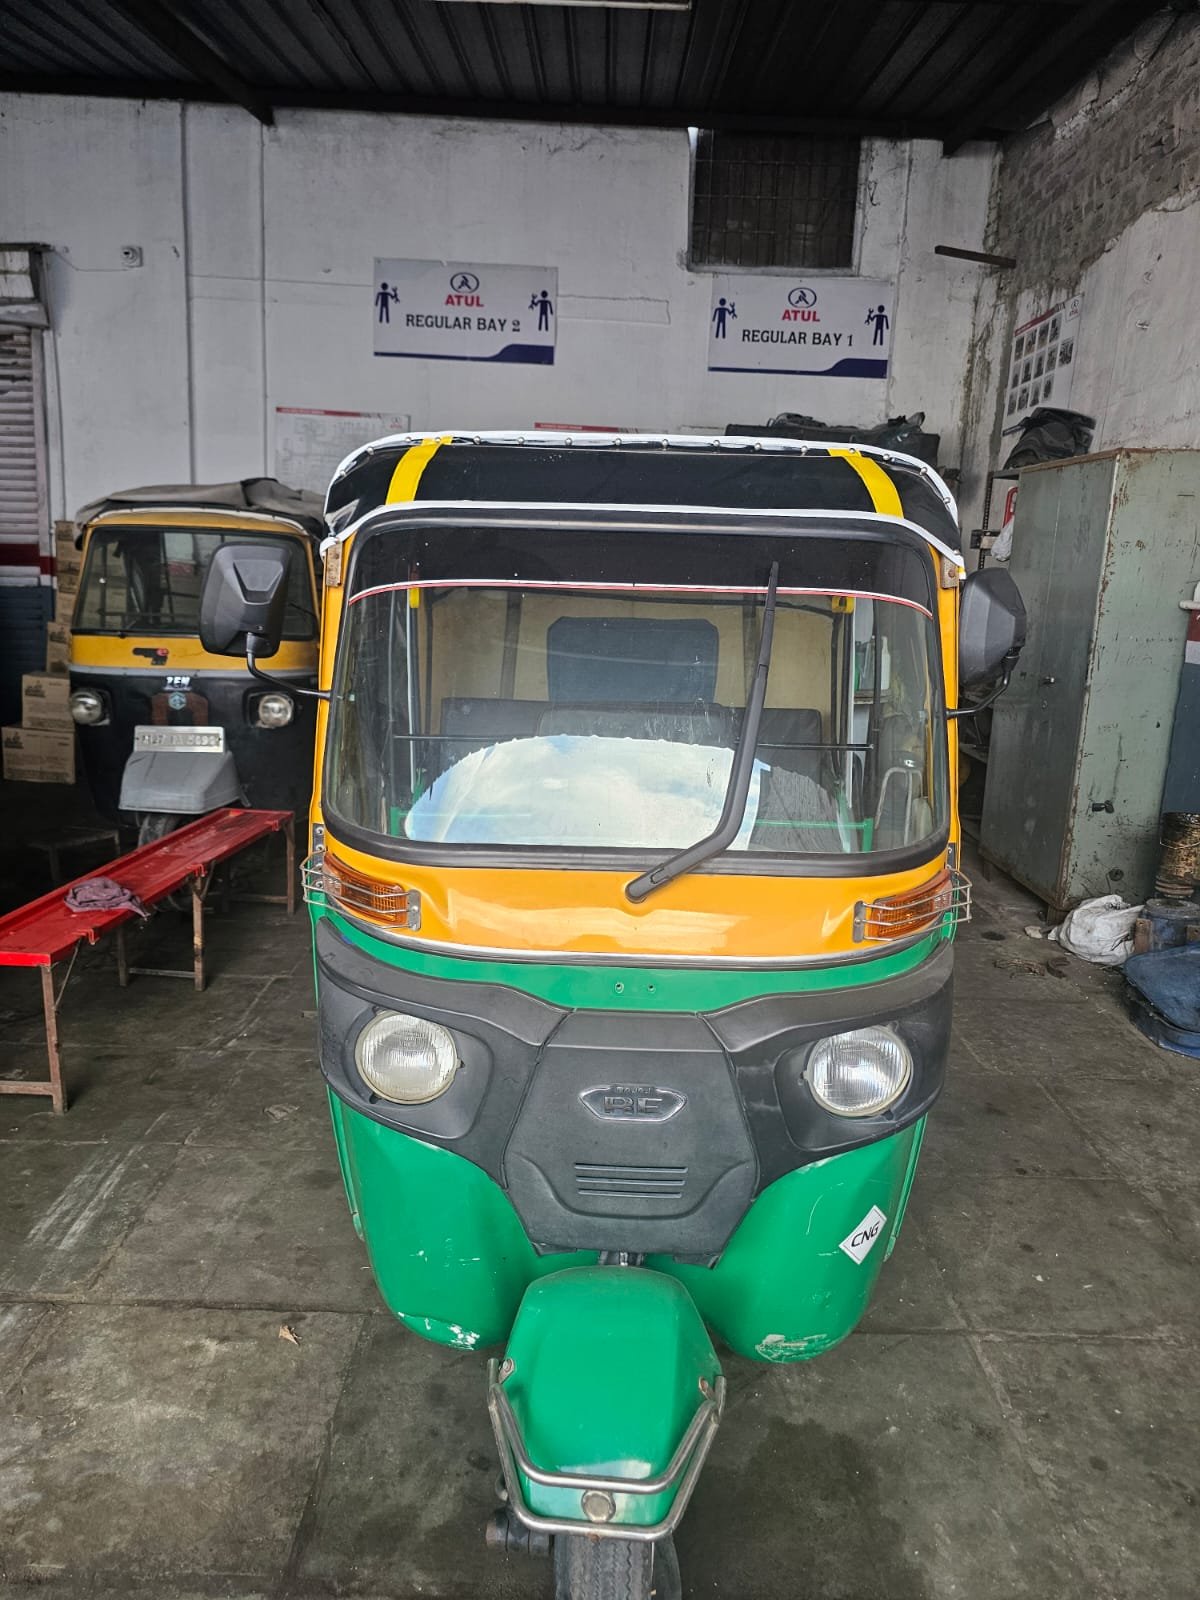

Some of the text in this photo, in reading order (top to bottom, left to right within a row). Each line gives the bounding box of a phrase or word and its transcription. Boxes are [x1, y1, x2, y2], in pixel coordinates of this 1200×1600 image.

[445, 294, 484, 307] ATUL
[405, 314, 521, 332] REGULAR BAY 2
[781, 309, 821, 322] ATUL
[741, 329, 853, 346] REGULAR BAY 1
[604, 1096, 663, 1115] RE
[851, 1220, 881, 1248] CNG
